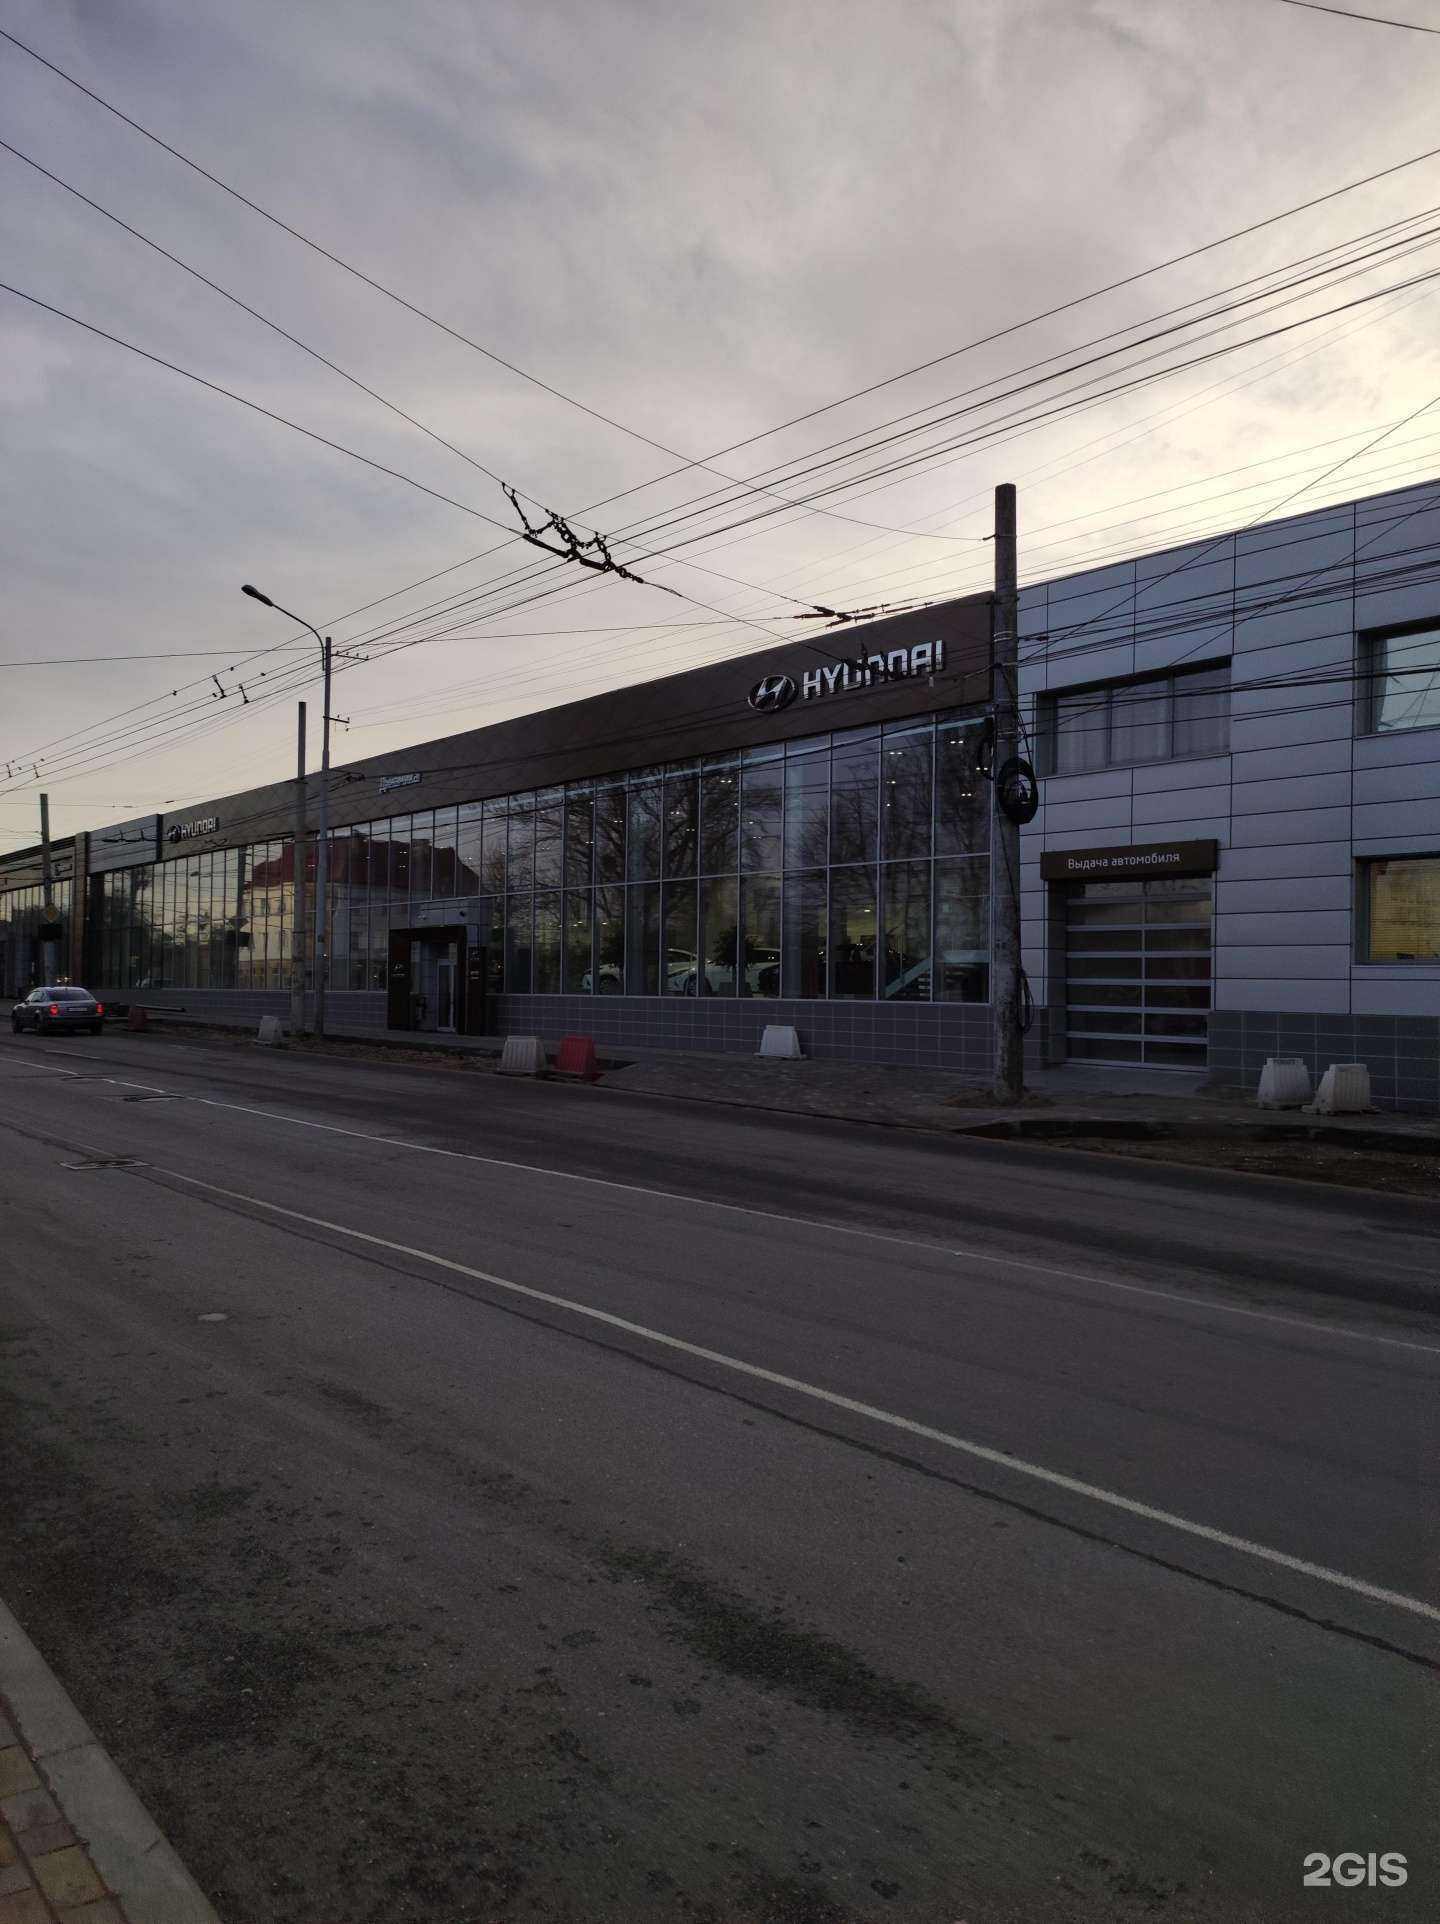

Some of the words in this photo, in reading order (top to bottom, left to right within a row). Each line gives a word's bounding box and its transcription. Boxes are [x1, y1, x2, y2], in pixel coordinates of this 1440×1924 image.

[803, 640, 943, 699] HYUNDAI
[1067, 858, 1109, 870] Выдача
[1111, 852, 1181, 866] автомобиля
